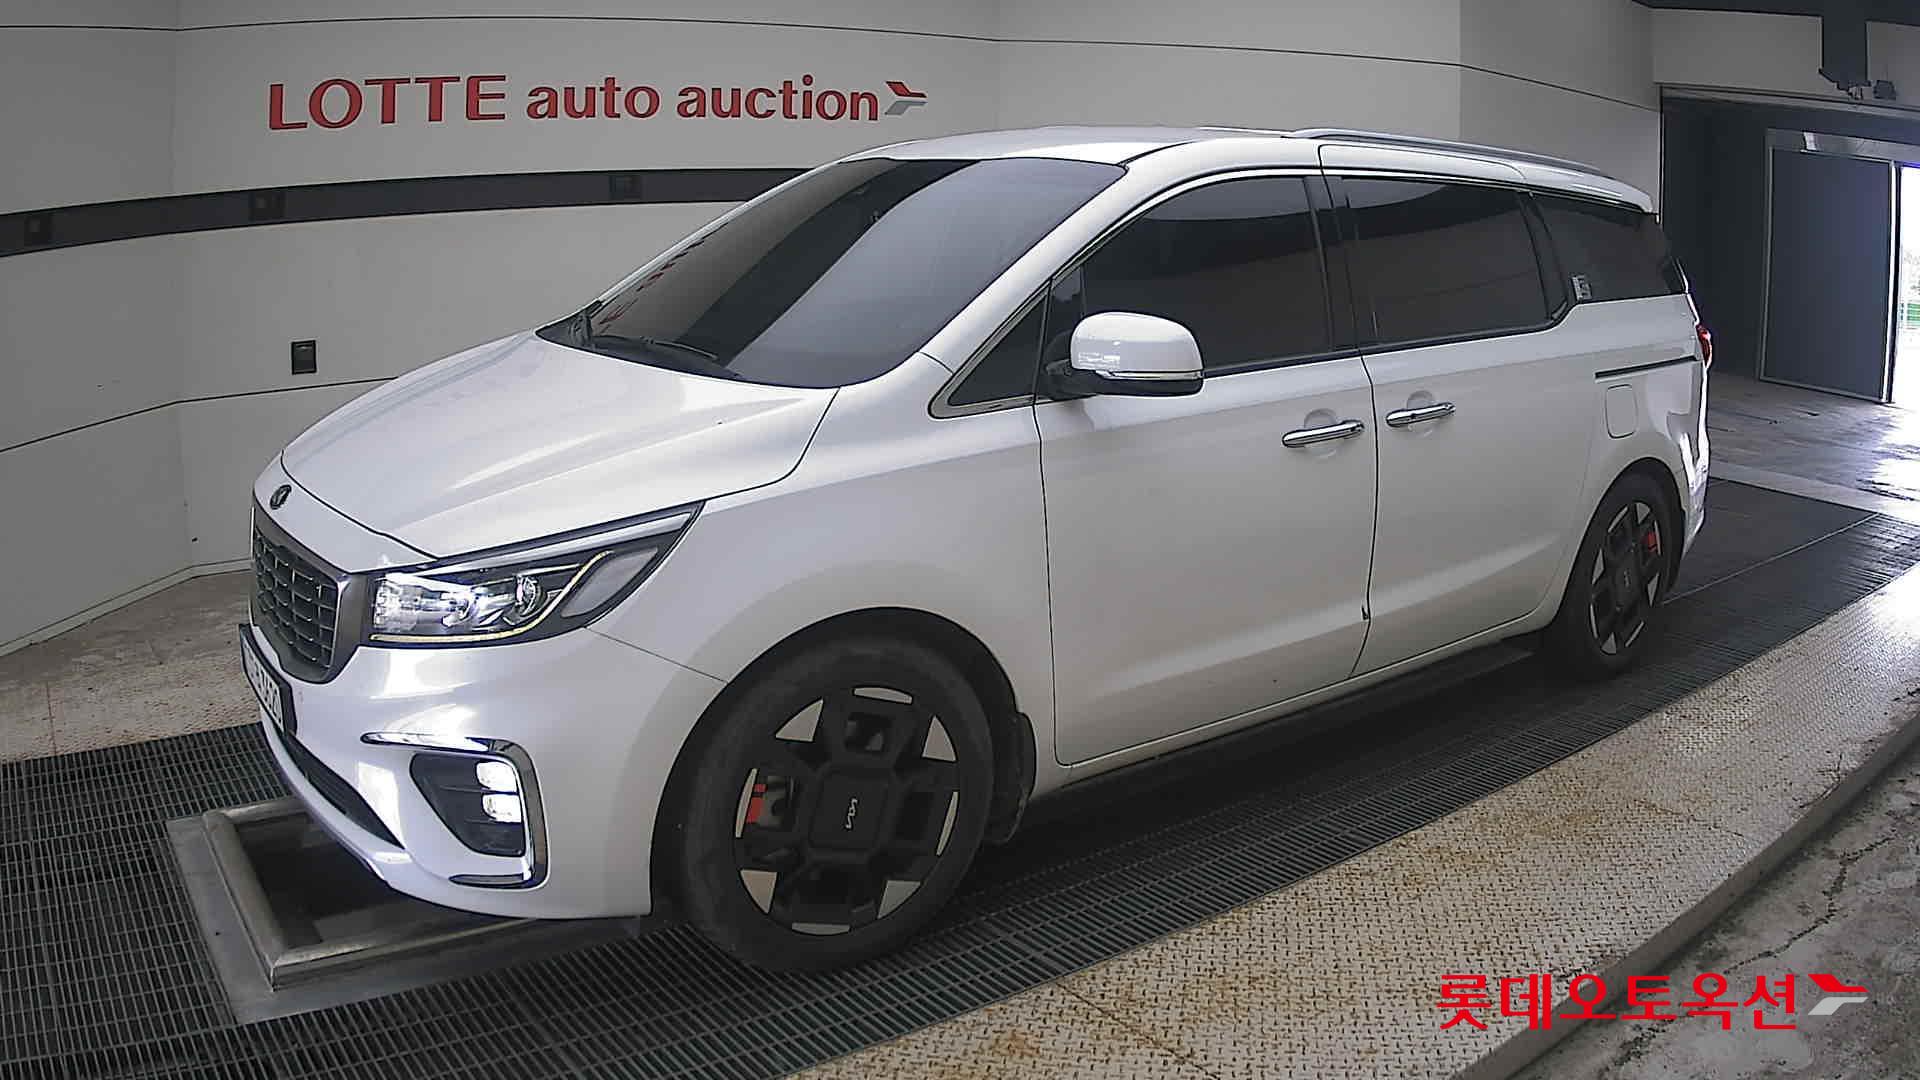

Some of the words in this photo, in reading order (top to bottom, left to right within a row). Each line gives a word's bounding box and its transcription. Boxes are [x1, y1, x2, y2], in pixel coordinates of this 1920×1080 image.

[269, 75, 506, 130] LOTTE
[526, 76, 660, 120] auto
[676, 74, 879, 121] auction
